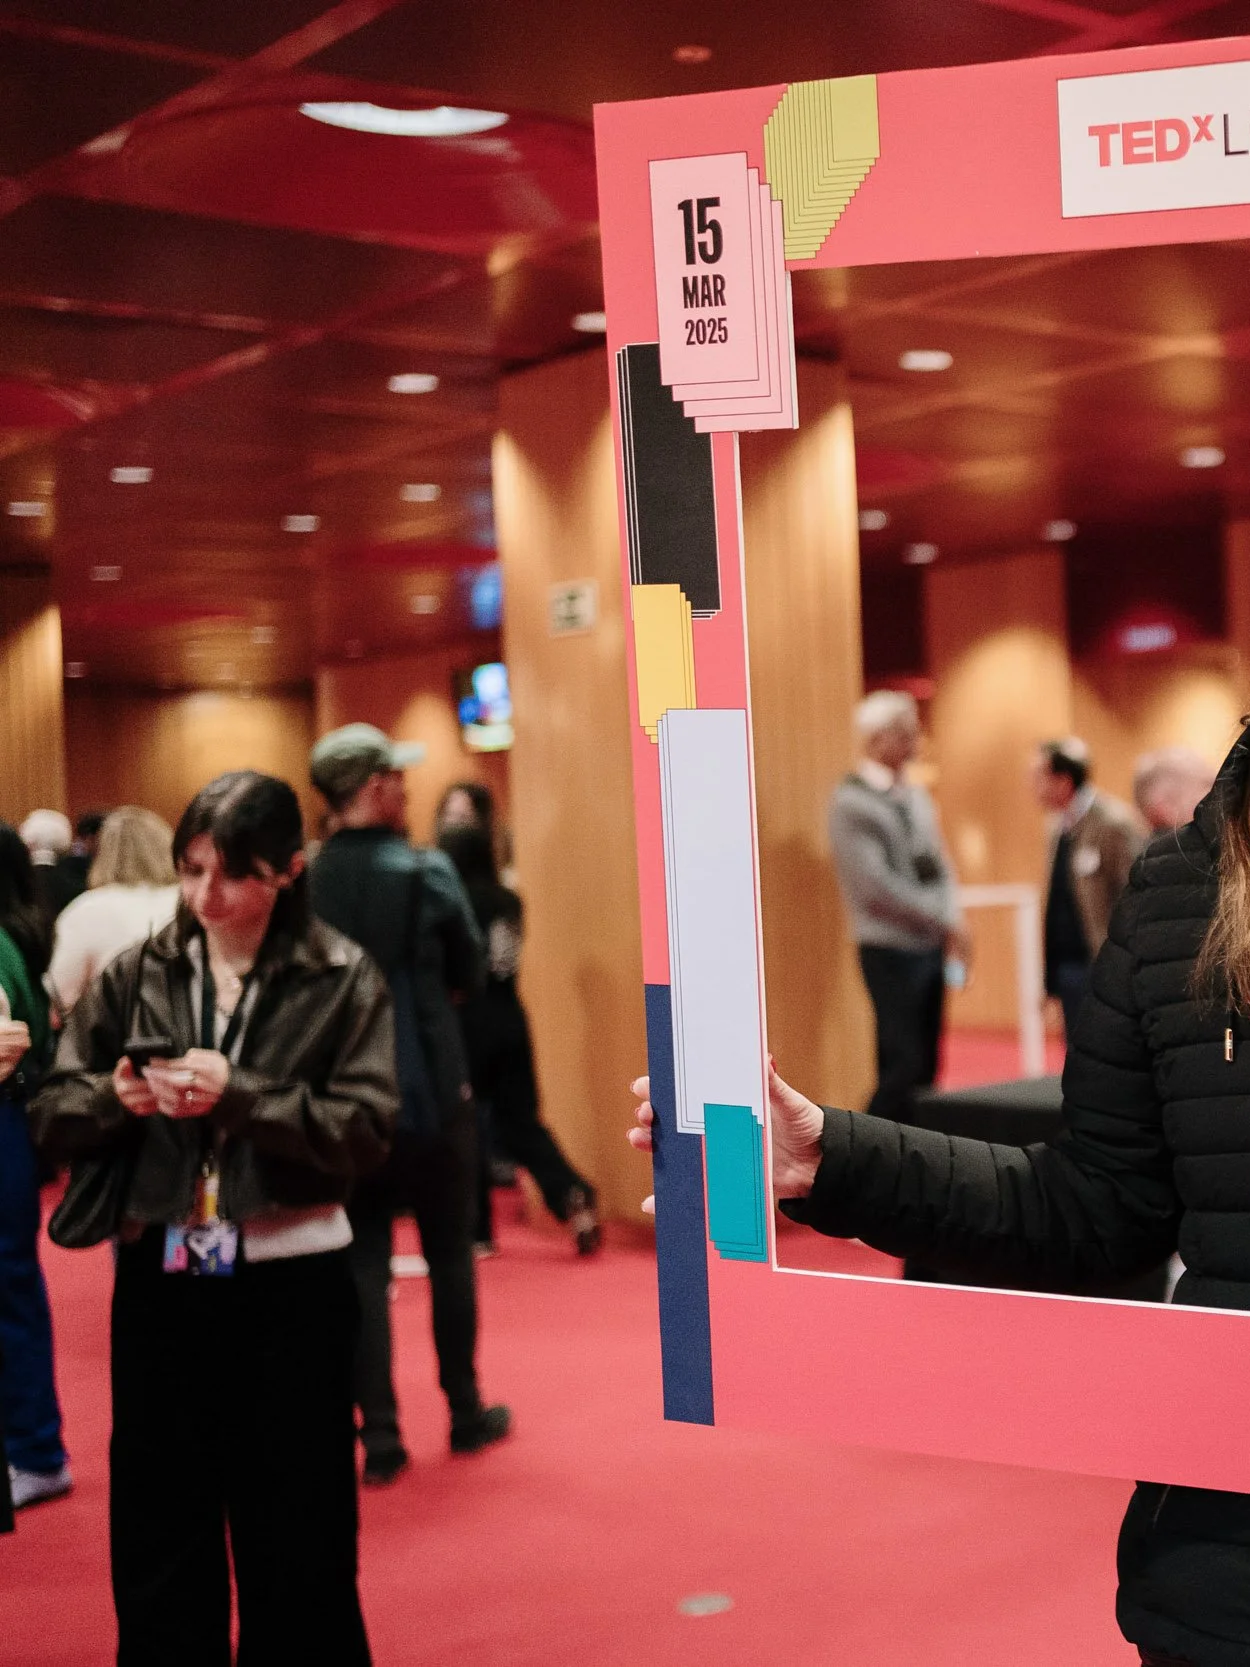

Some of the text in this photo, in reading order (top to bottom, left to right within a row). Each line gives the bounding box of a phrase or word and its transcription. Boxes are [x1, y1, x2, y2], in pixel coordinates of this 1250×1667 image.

[677, 196, 724, 265] 15
[682, 274, 727, 309] MAR
[685, 317, 729, 346] 2025
